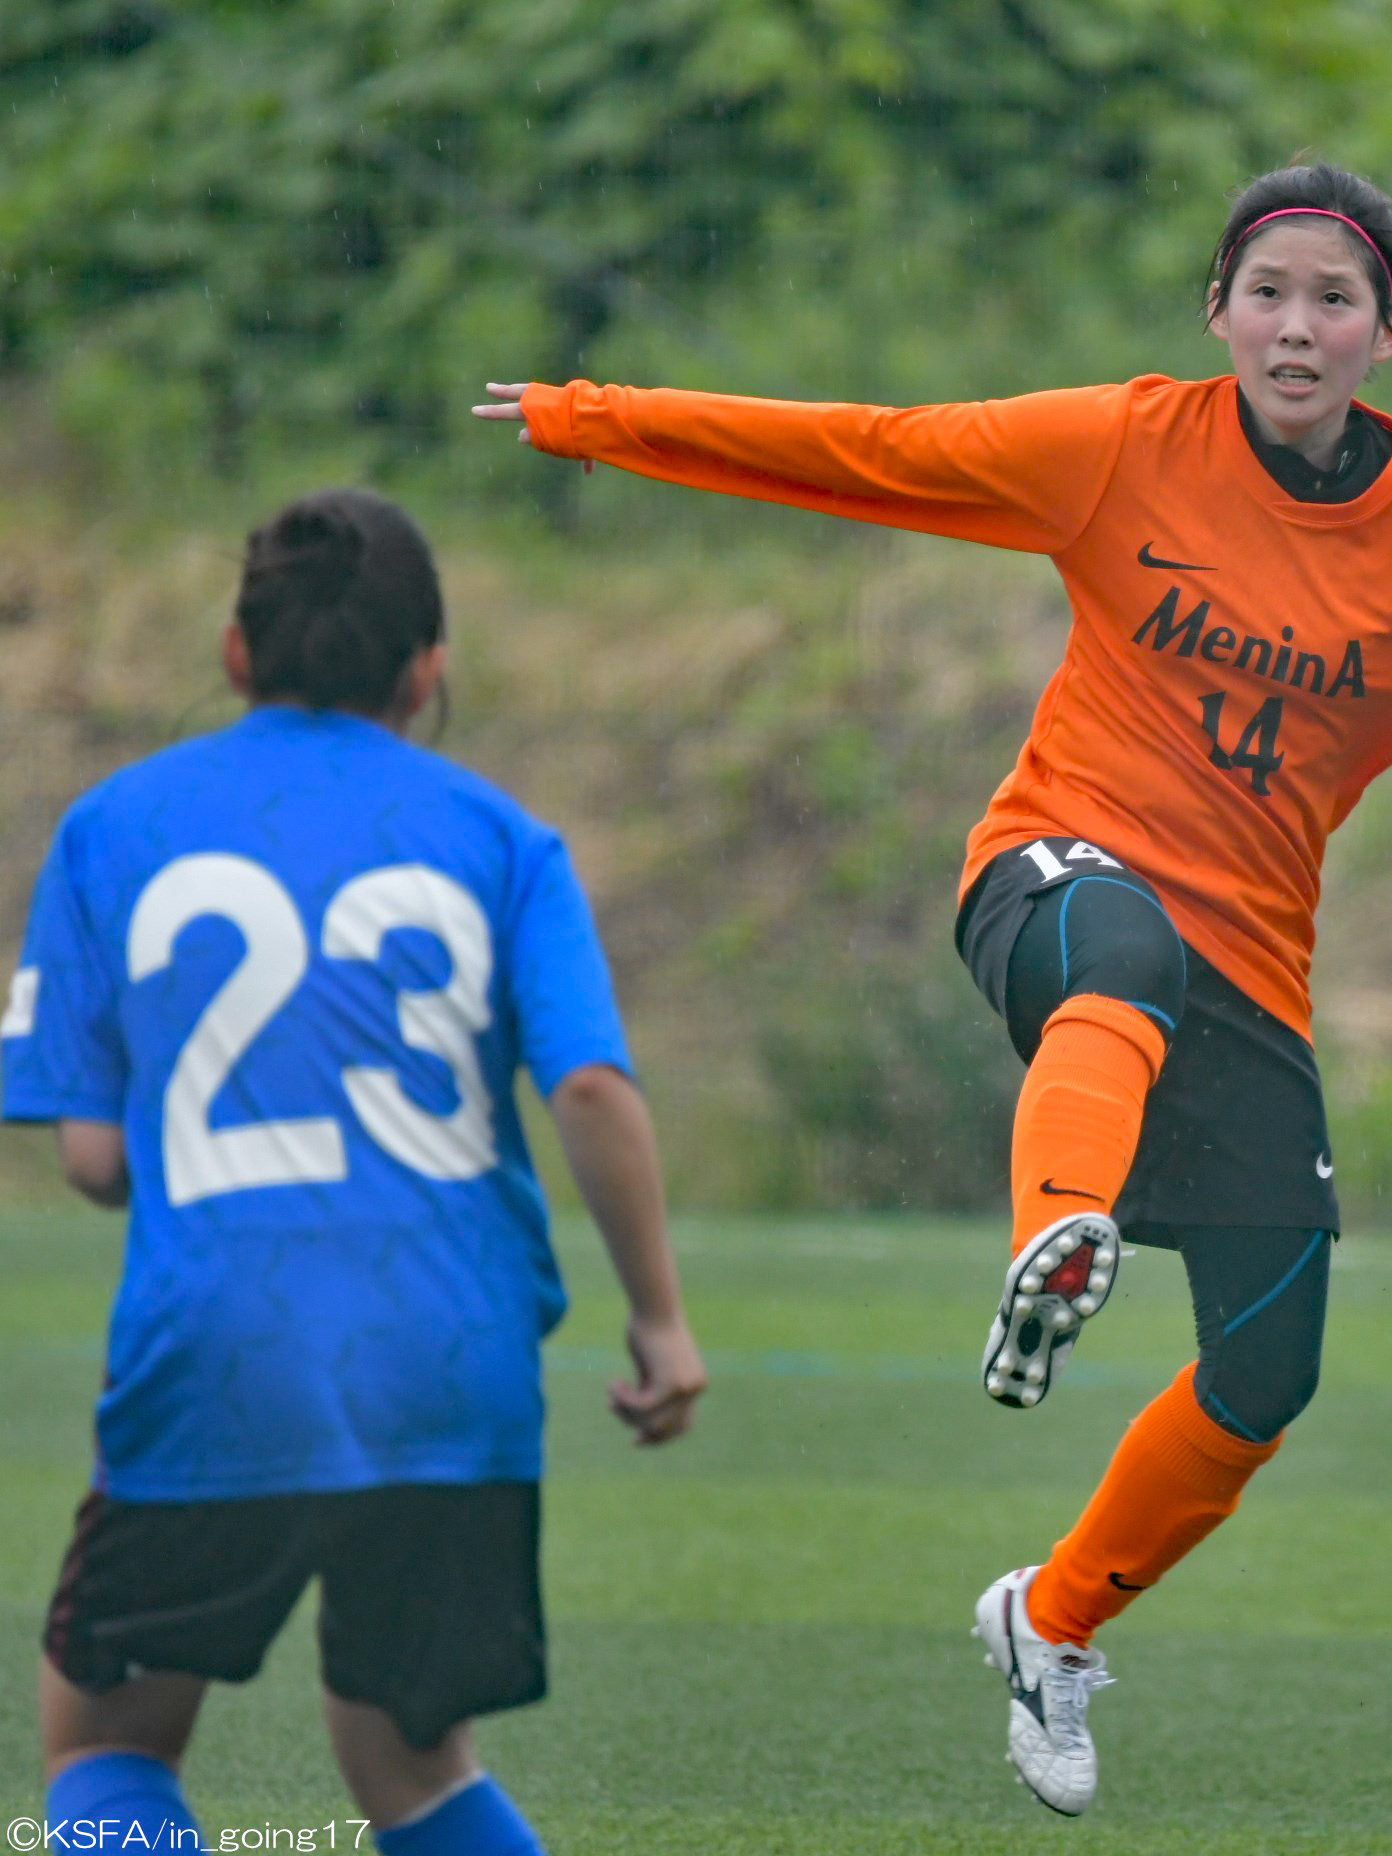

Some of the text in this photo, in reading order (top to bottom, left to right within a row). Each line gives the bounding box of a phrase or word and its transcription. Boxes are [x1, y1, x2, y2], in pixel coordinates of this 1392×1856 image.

[1131, 586, 1366, 698] MeninA
[1198, 690, 1285, 797] 14
[1019, 839, 1125, 884] 14
[126, 850, 498, 1208] 23
